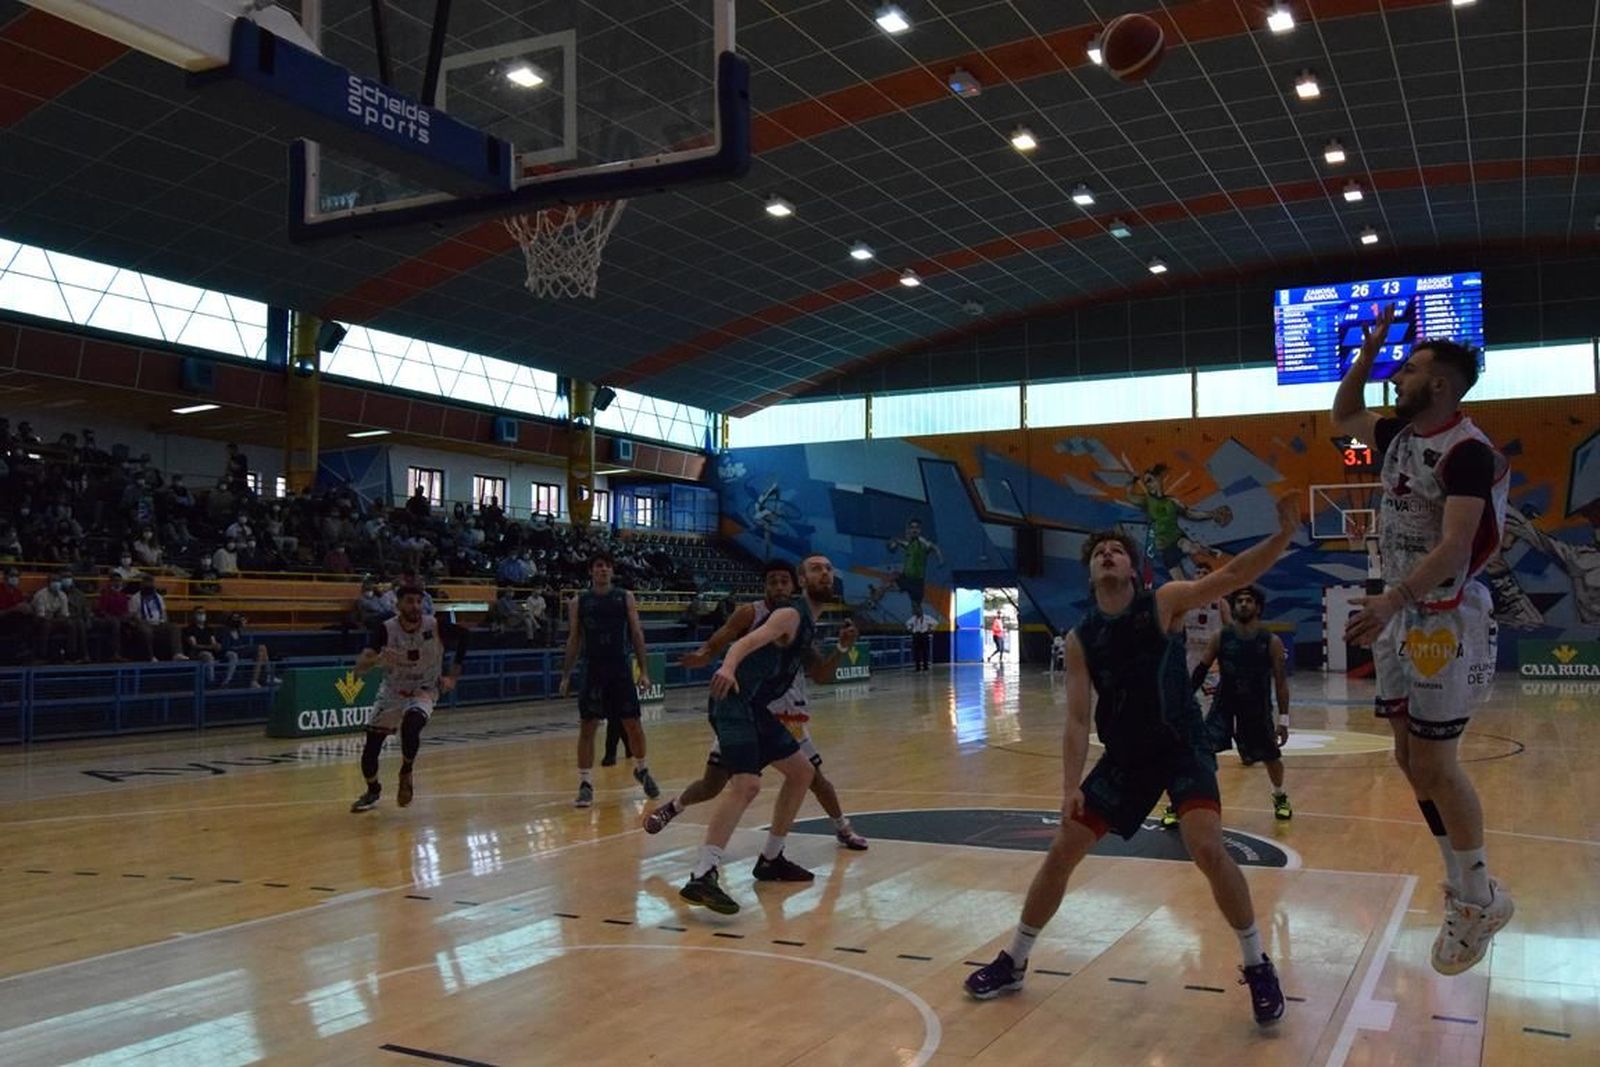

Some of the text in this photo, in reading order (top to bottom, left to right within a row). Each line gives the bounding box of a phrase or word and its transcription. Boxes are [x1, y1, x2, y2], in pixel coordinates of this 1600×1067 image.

[348, 76, 430, 127] Schelde
[348, 95, 430, 144] Sports
[1351, 284, 1369, 298] 26
[1382, 281, 1400, 295] 13
[1392, 345, 1403, 360] 5
[1344, 449, 1372, 466] 3.1
[1398, 641, 1465, 658] ZAMORA
[1521, 664, 1600, 676] CAJA RURA
[1467, 673, 1484, 685] DE
[298, 705, 375, 731] CAJA RUR
